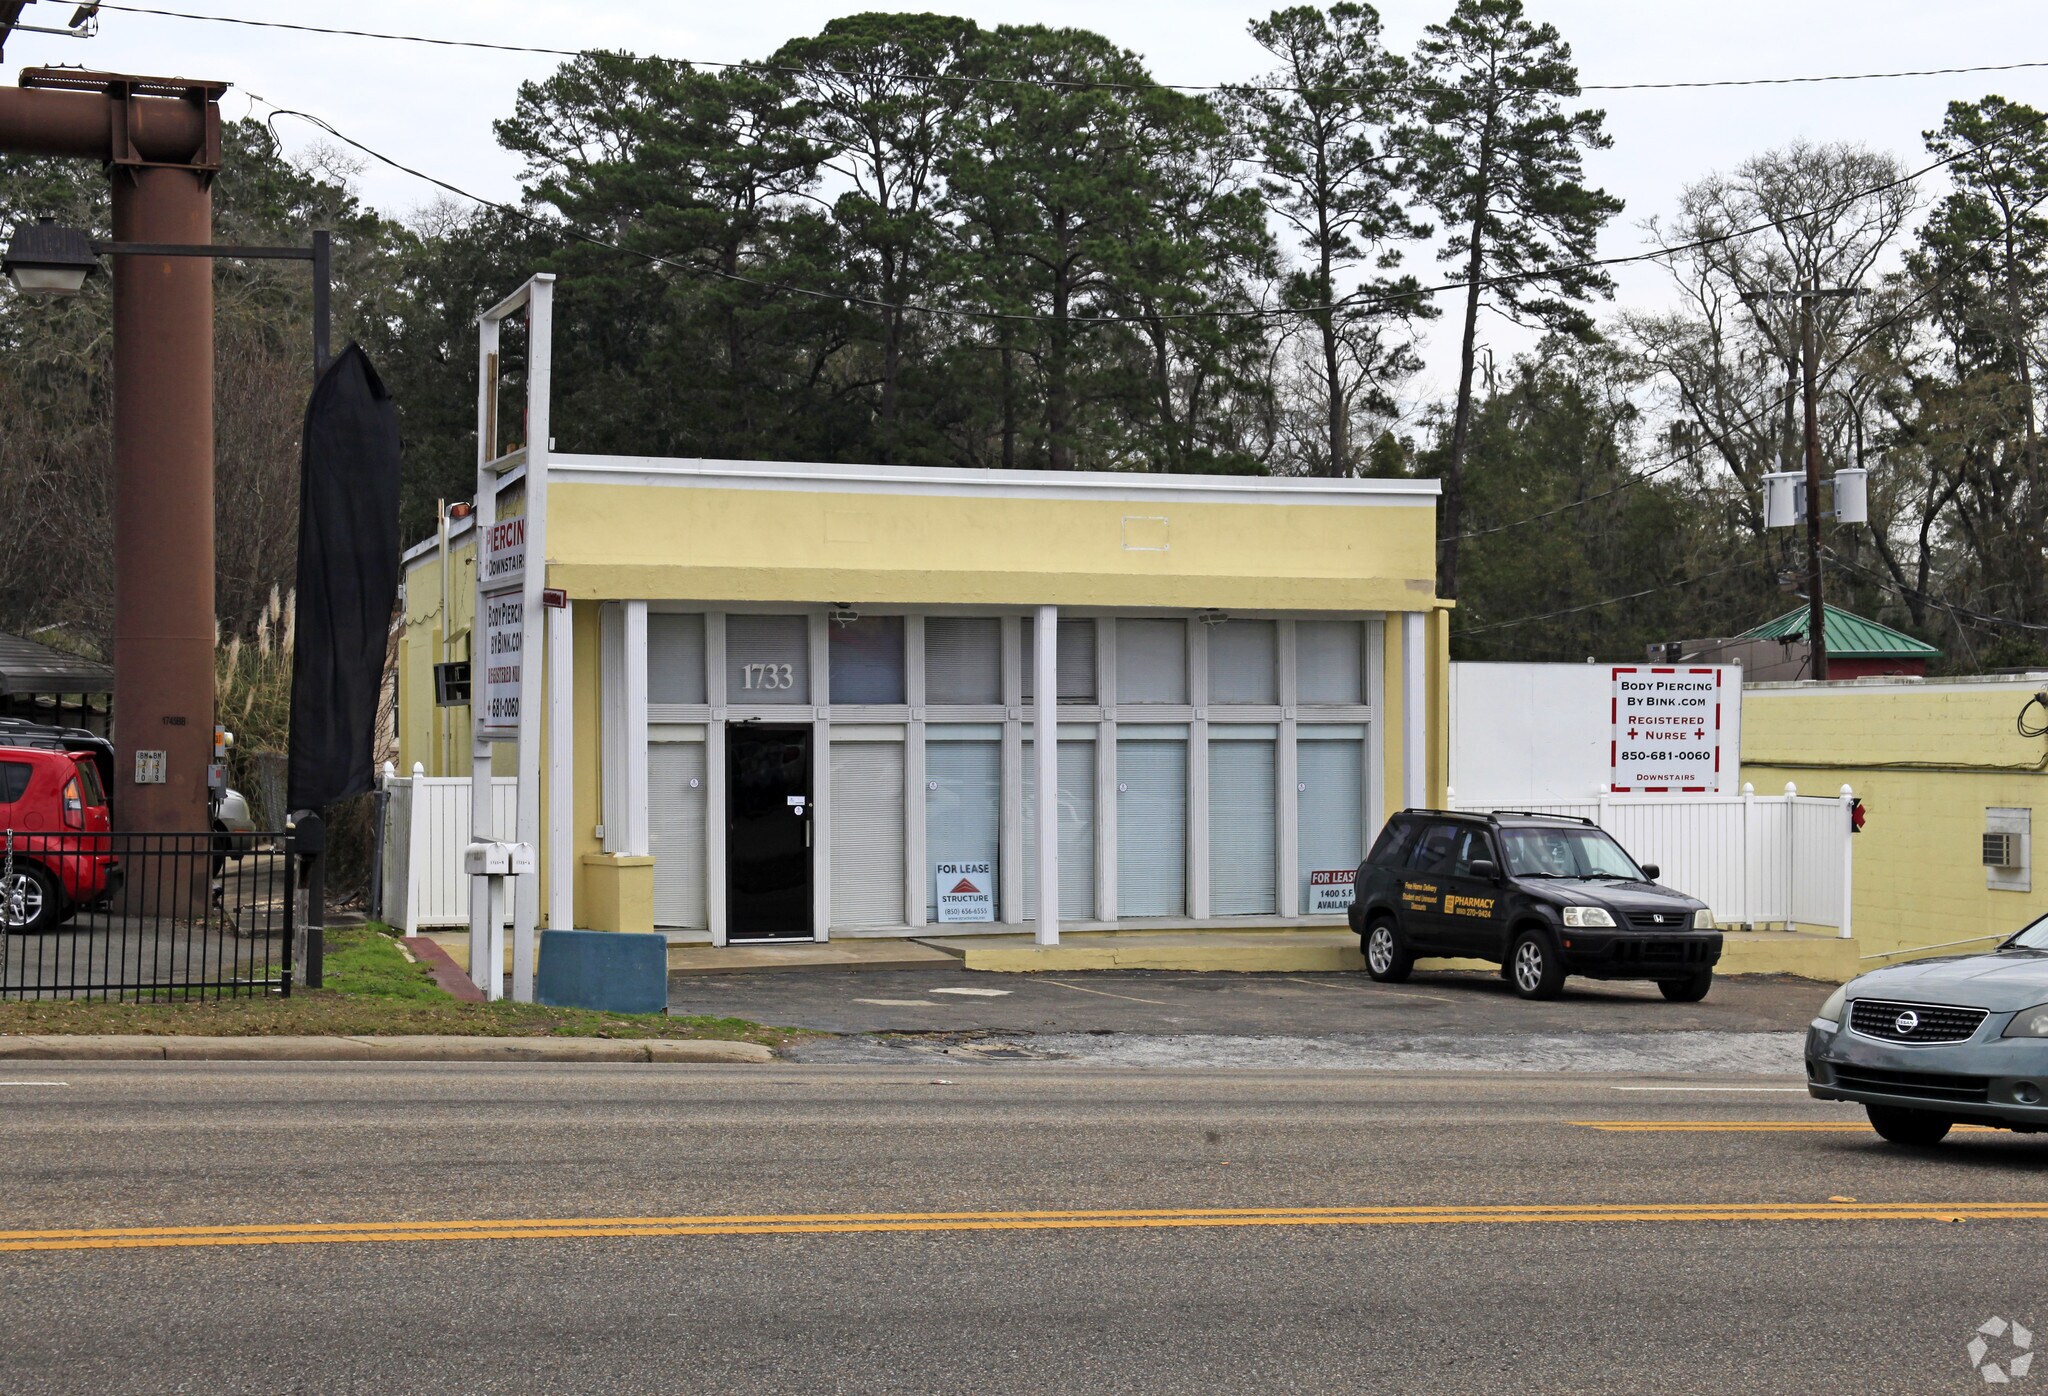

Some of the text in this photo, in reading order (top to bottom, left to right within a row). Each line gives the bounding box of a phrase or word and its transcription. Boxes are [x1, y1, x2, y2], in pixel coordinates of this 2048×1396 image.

[742, 663, 794, 689] 1733
[1621, 681, 1712, 691] BODY PIERCING
[1627, 697, 1644, 706] BY
[492, 697, 519, 718] 681-0060
[1628, 715, 1705, 725] REGISTERED
[1645, 731, 1687, 740] NURSE
[1621, 751, 1711, 761] 850-681-0060
[1636, 773, 1696, 781] DOWNSTAIRS
[937, 864, 990, 874] FOR LEASE
[1312, 872, 1330, 884] FOR
[1320, 889, 1340, 898] 1400
[1455, 896, 1495, 909] PHARMACY
